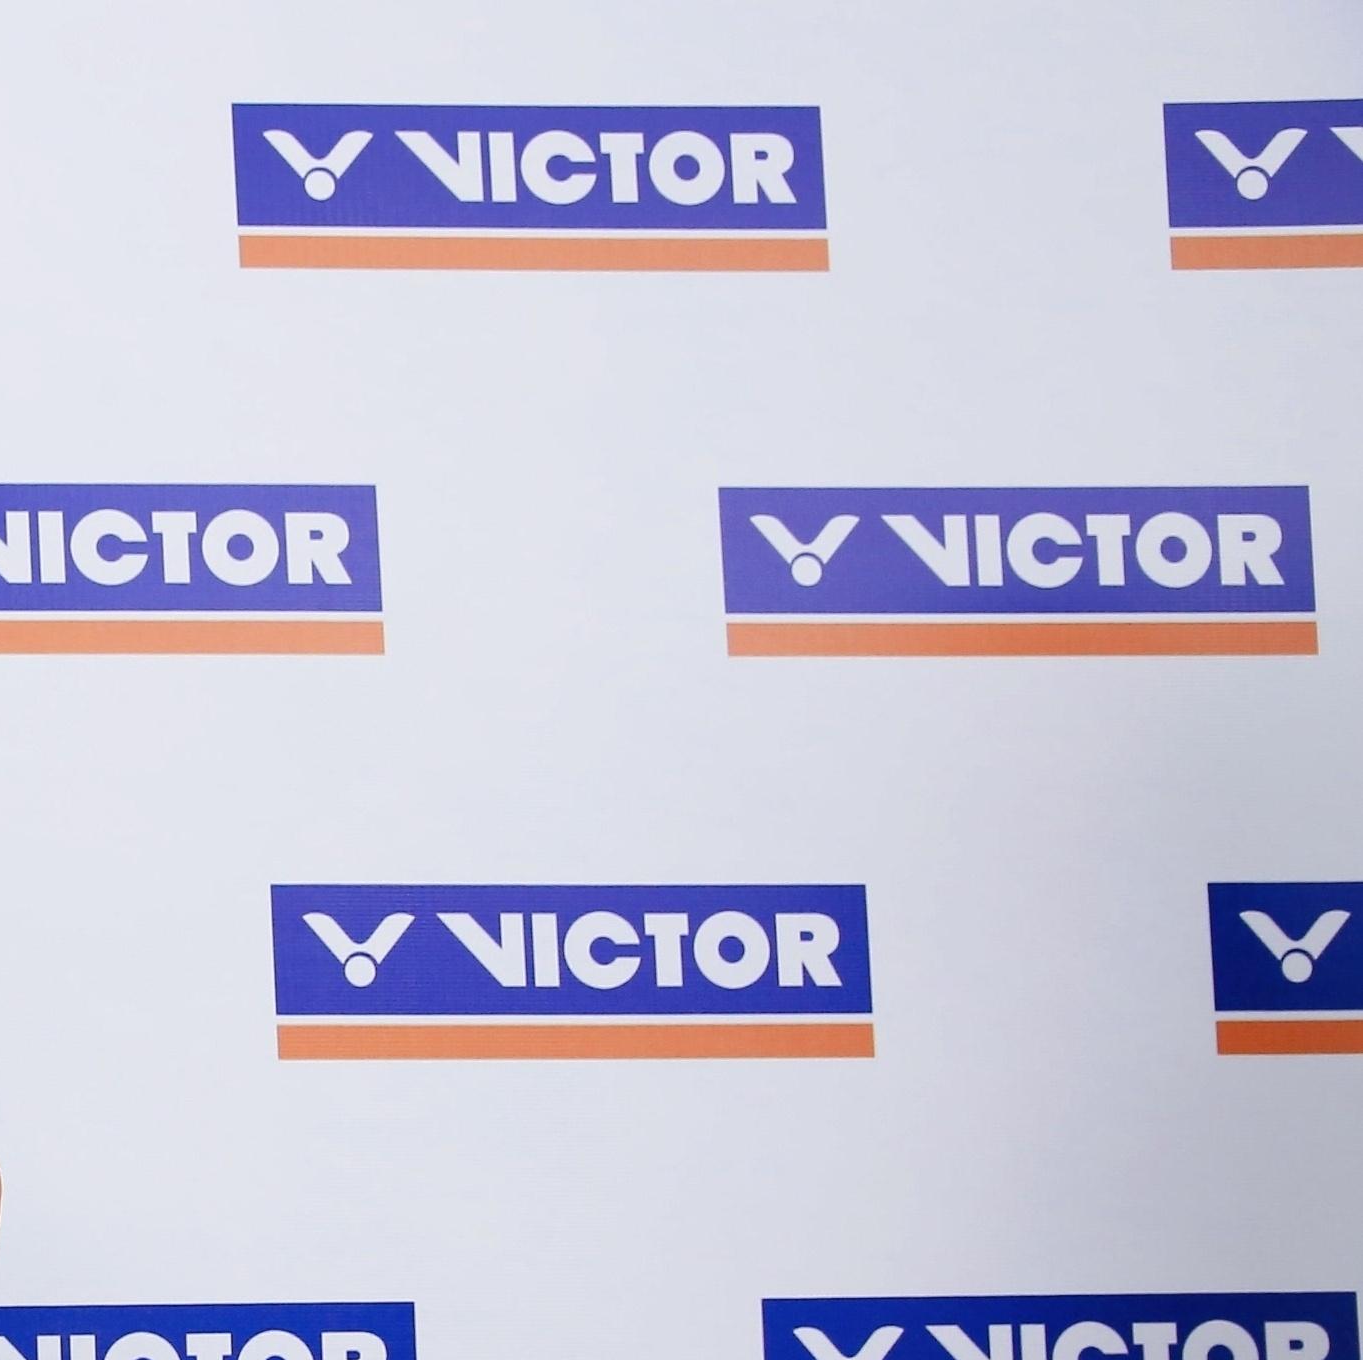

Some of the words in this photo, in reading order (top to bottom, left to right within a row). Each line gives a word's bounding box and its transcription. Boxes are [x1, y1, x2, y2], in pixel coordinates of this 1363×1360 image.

[395, 131, 796, 205] VICTOR
[881, 512, 1284, 588] VICTOR
[437, 911, 841, 989] VICTOR
